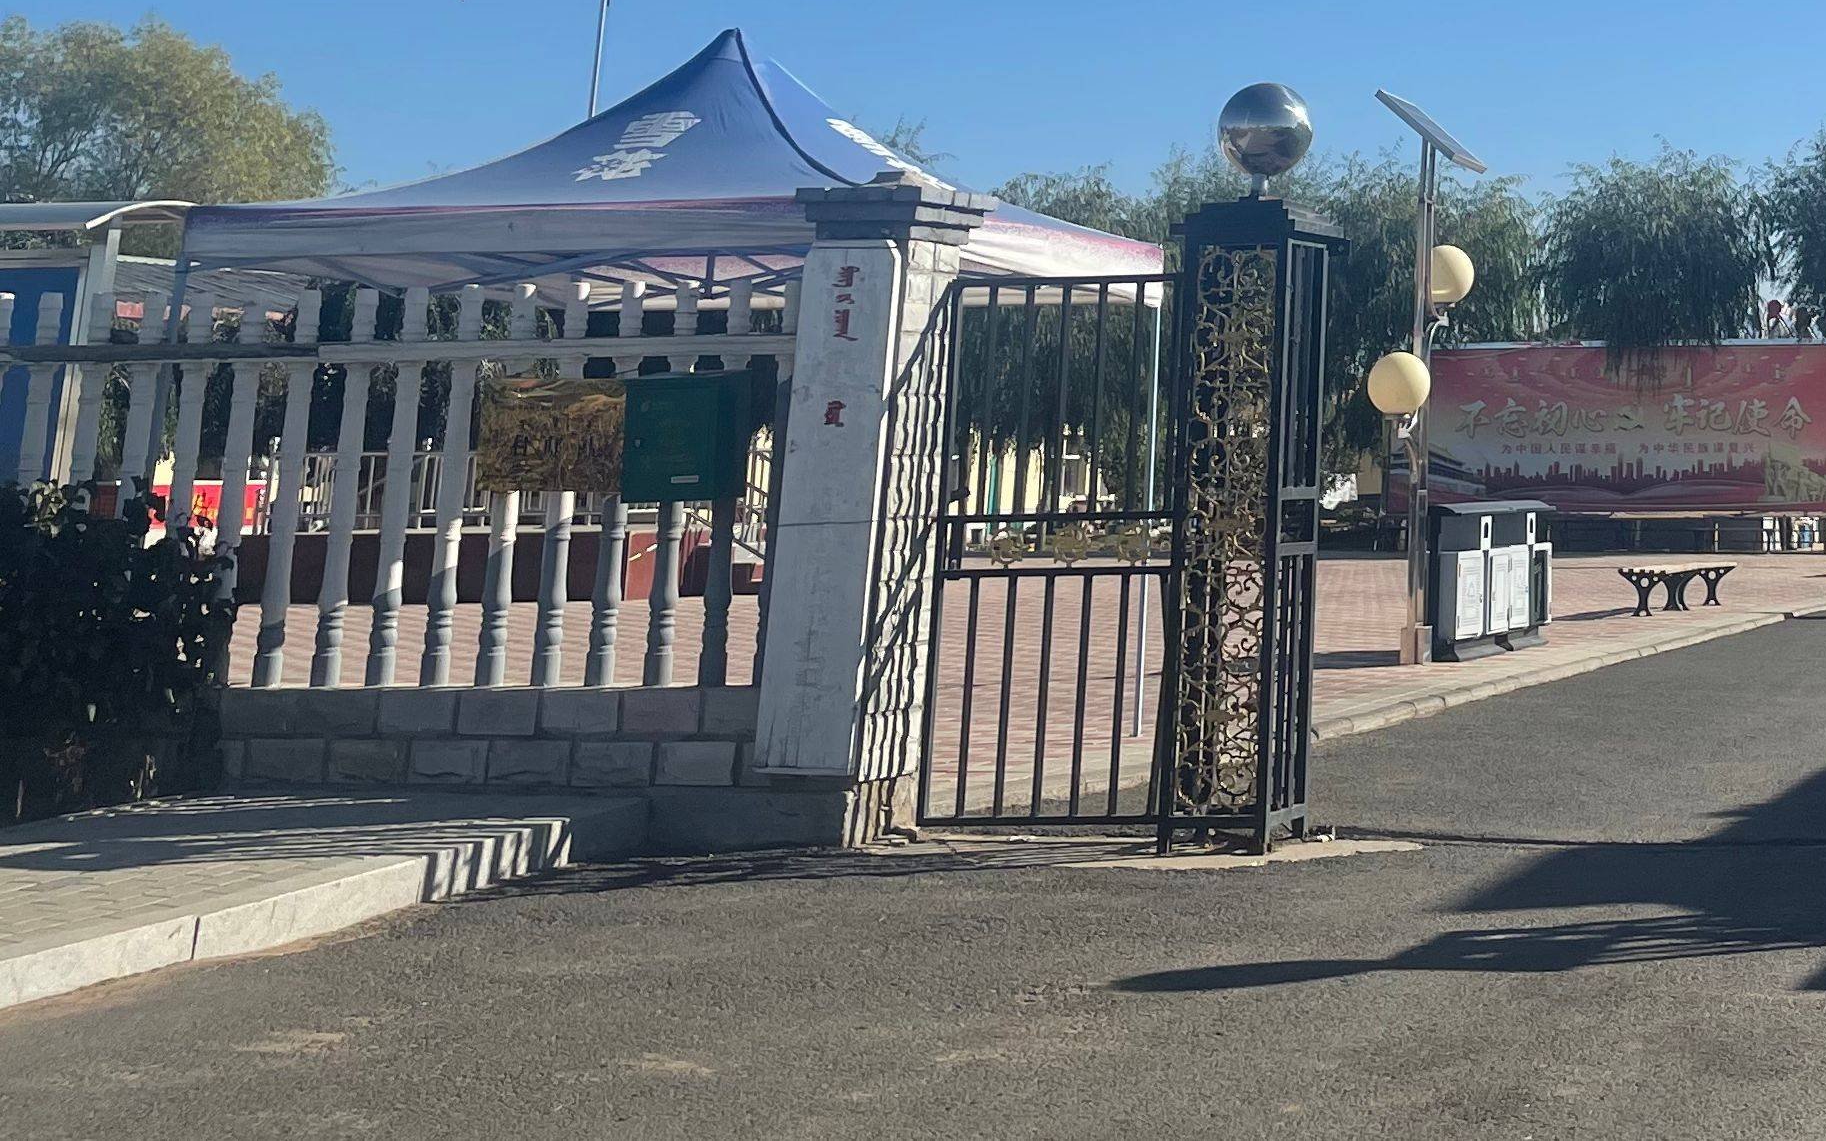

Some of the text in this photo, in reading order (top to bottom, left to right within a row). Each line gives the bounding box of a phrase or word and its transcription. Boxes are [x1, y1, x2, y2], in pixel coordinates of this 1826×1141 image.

[1455, 393, 1813, 440] 不忘初心 牢记使命
[1501, 441, 1756, 456] 为中国人民谋幸福 为中华民族谋复兴
